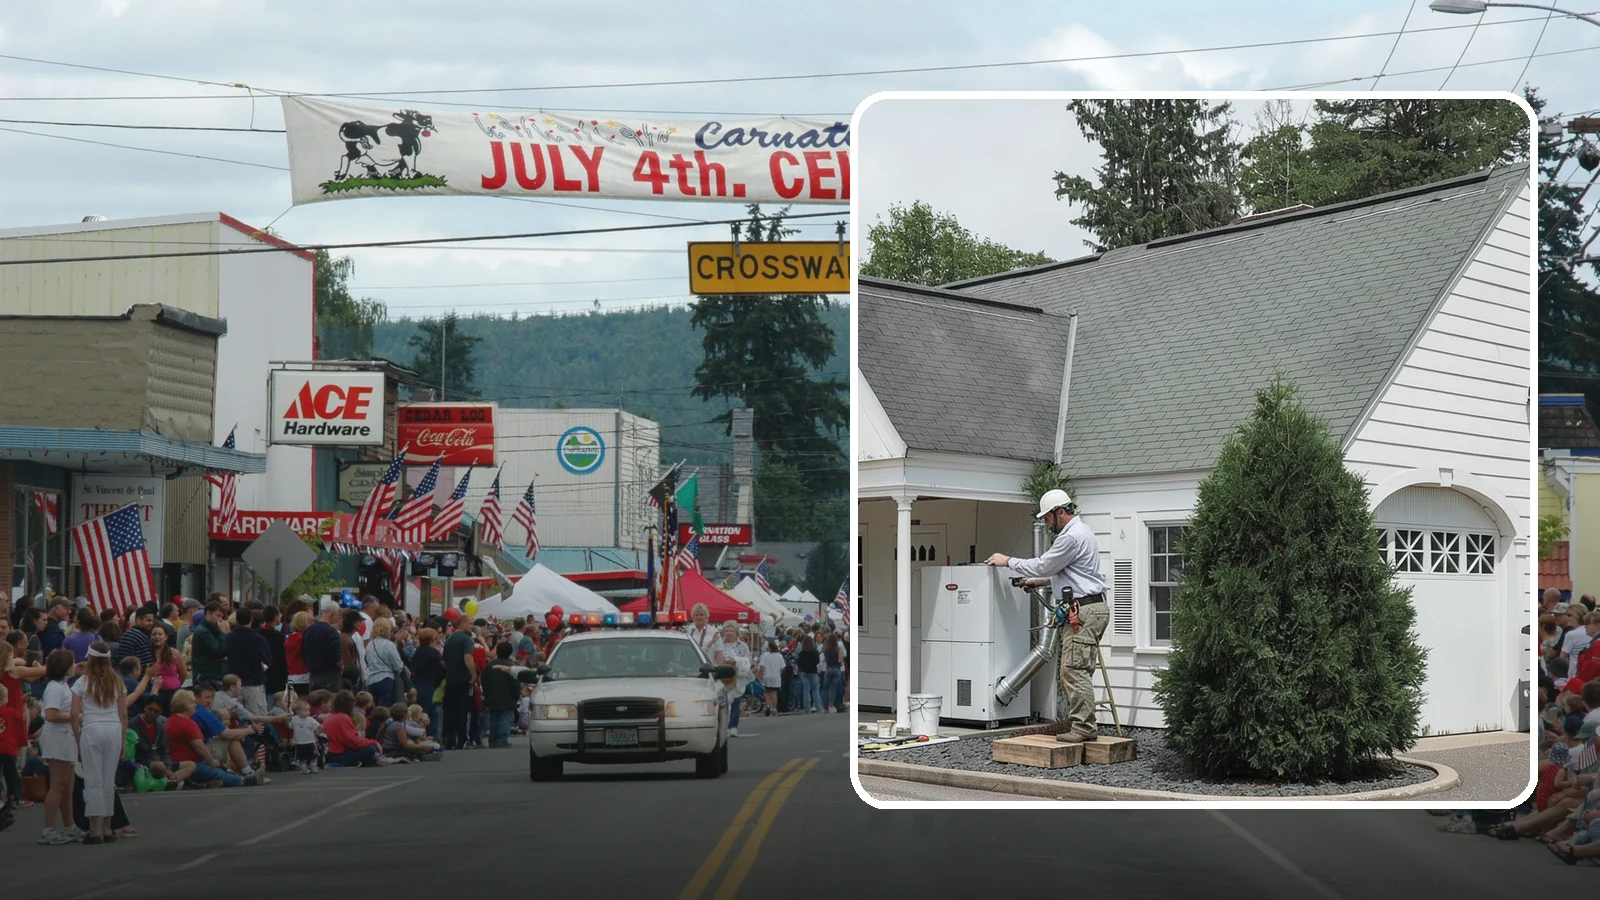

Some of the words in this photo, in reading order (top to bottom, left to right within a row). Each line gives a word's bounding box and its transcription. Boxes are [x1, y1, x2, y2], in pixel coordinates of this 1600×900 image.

[481, 141, 604, 192] JULY
[632, 150, 746, 197] 4th.
[697, 254, 850, 279] CROSSWA
[283, 380, 373, 420] ACE
[405, 409, 452, 421] CEDAR
[461, 409, 485, 421] LOG
[283, 421, 370, 436] Hardware
[416, 428, 476, 447] Coca-Cola
[354, 467, 385, 479] Simpl
[96, 485, 124, 494] Vincent
[126, 486, 135, 494] de
[137, 486, 155, 495] Paul
[688, 526, 741, 535] CRNATION
[699, 535, 730, 543] GLASS
